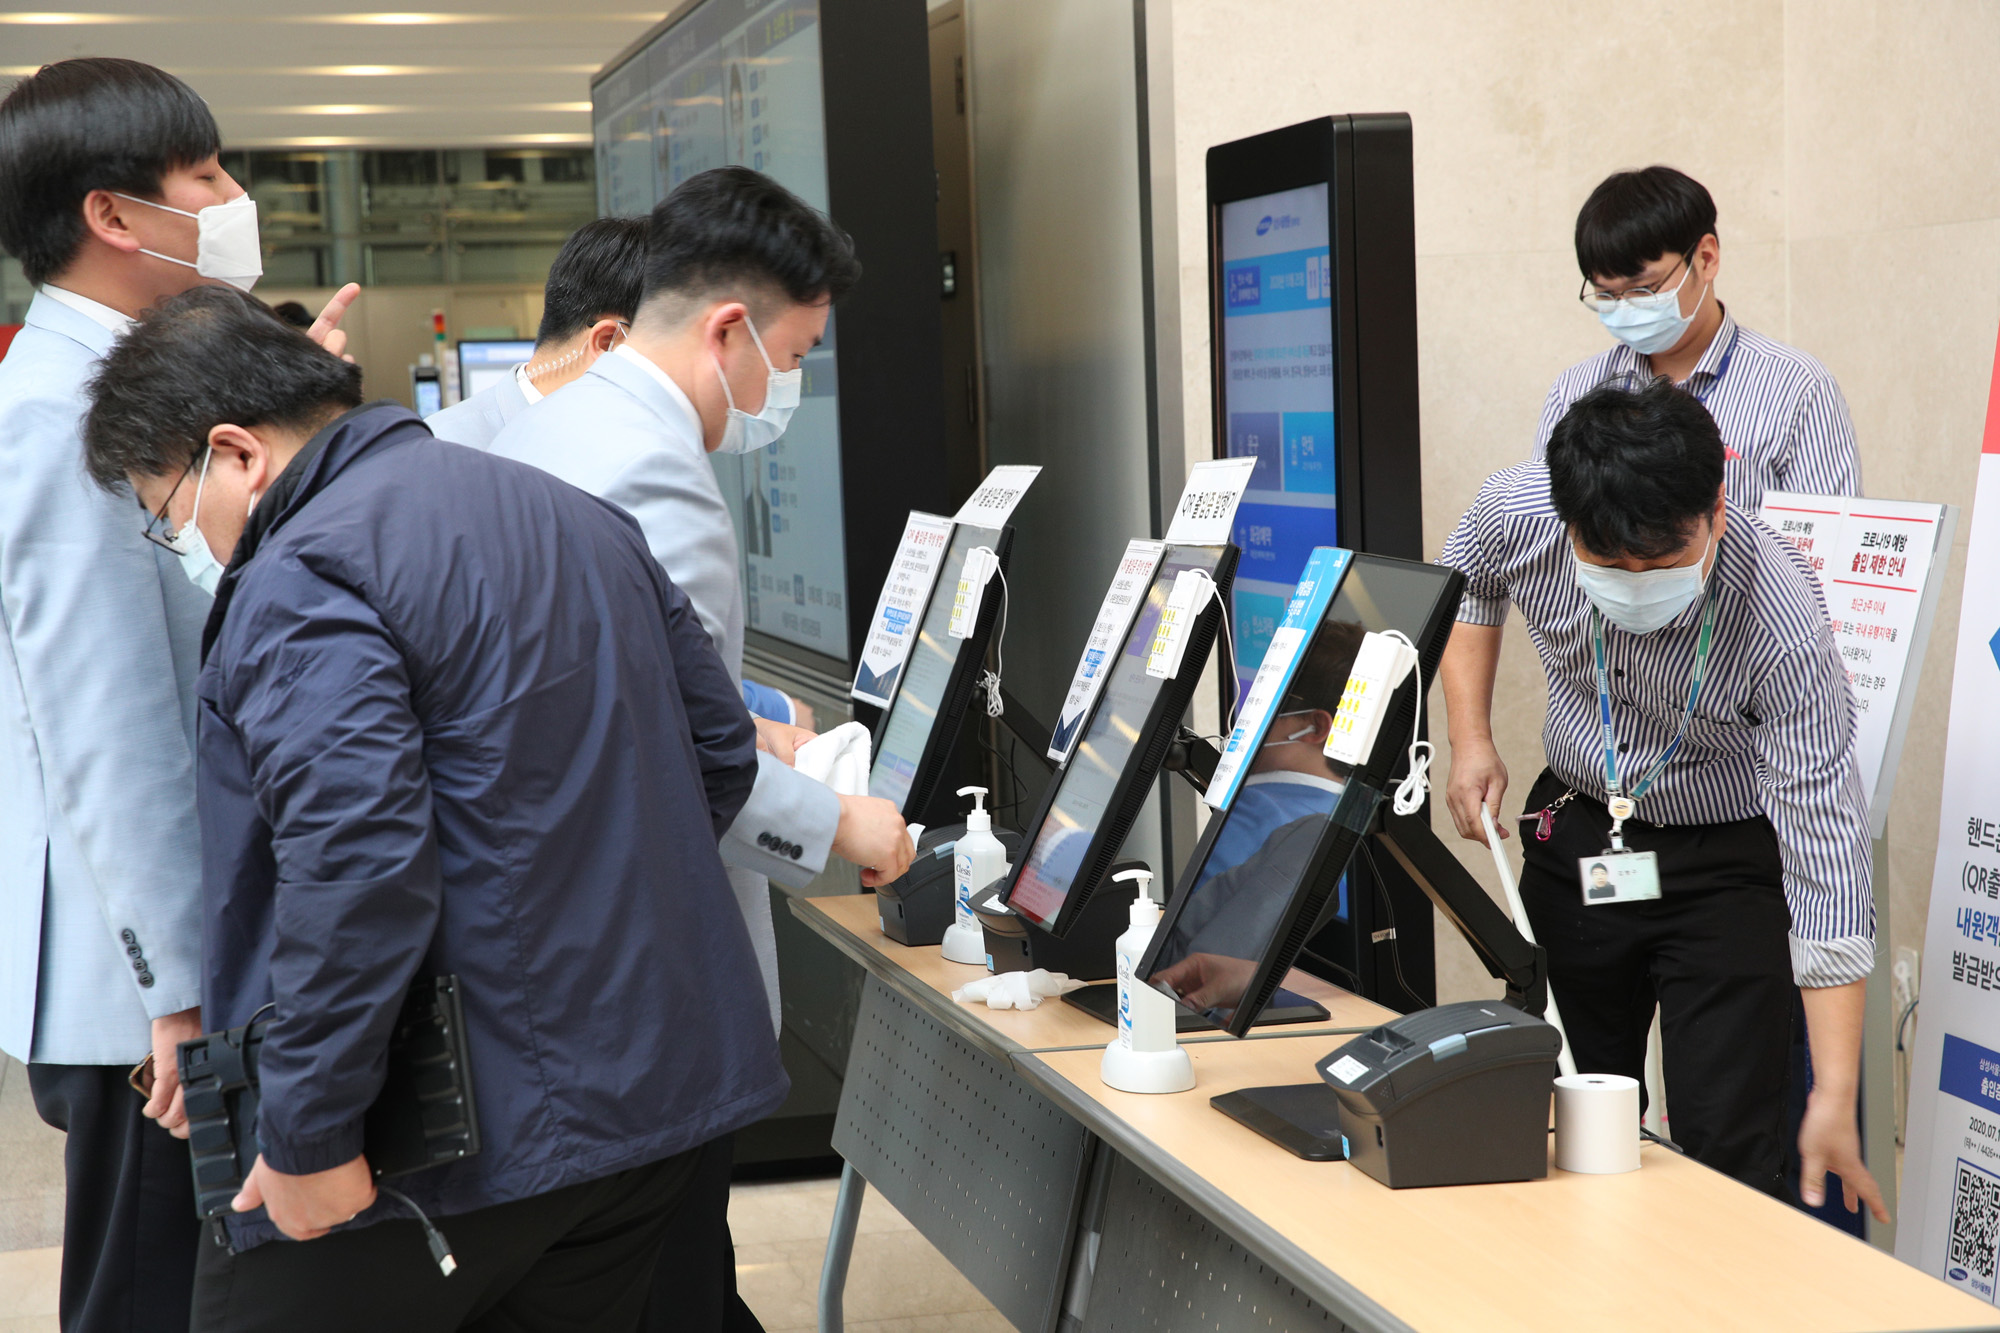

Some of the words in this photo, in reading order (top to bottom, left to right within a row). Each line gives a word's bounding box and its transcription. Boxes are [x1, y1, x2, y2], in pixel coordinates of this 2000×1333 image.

[1182, 493, 1196, 517] QR
[1191, 491, 1217, 519] 출입증
[1212, 490, 1239, 519] 발행기
[1861, 531, 1892, 550] 코로나19
[1892, 533, 1908, 553] 예방
[1851, 552, 1869, 573] 출입
[1869, 553, 1888, 576] 제한
[1887, 556, 1907, 578] 안내
[1855, 622, 1868, 638] 국내
[1860, 672, 1873, 689] 있는
[1873, 675, 1886, 691] 경우
